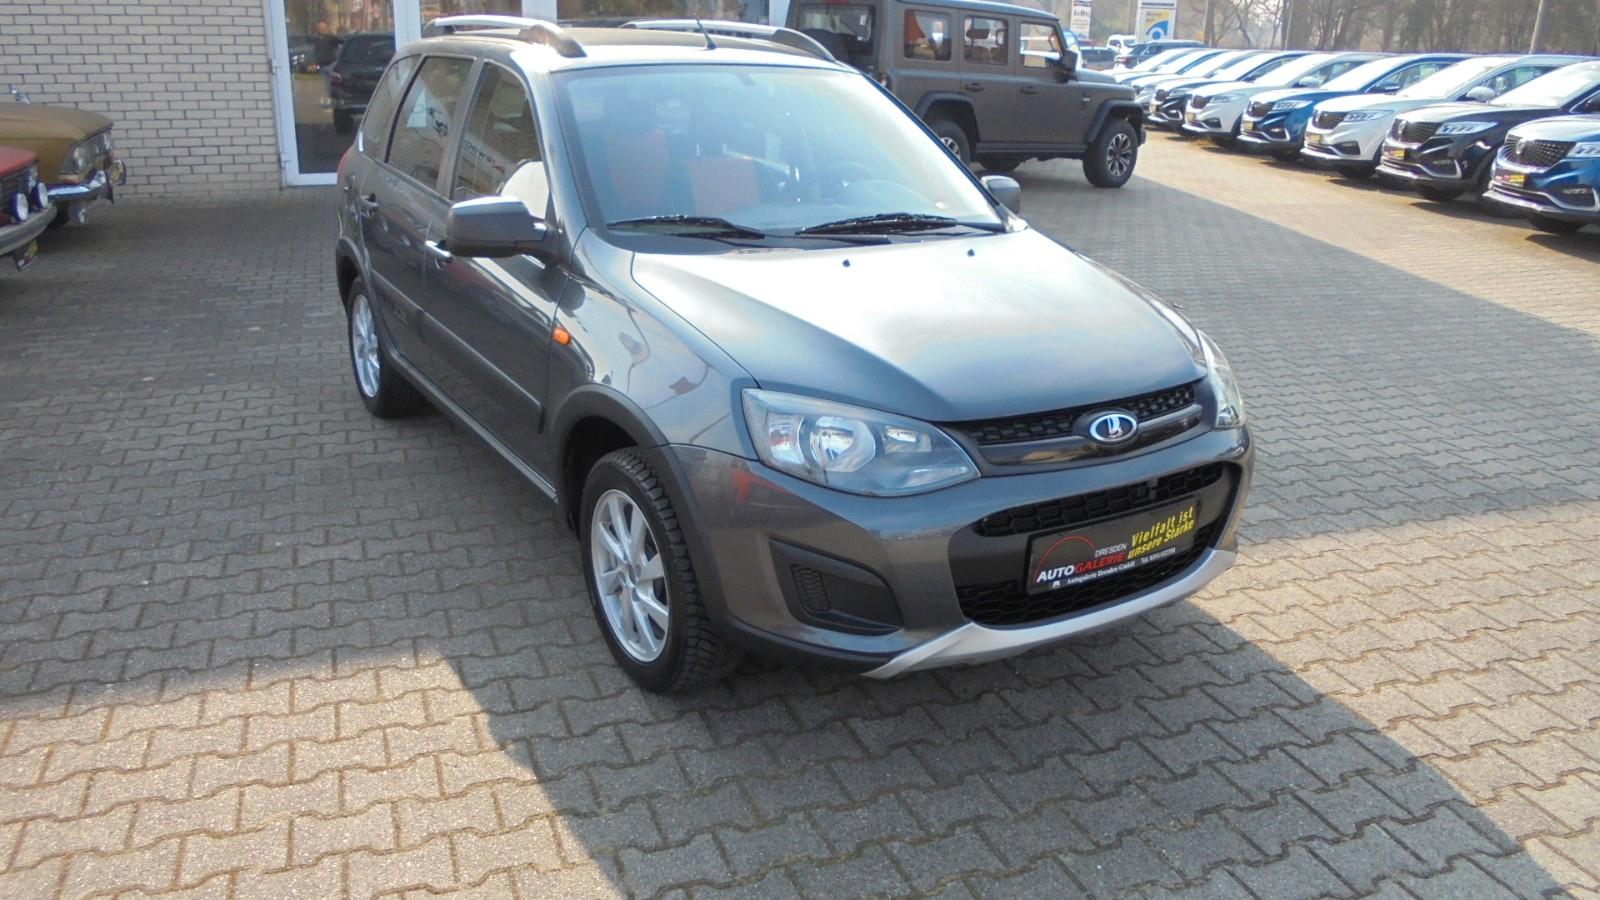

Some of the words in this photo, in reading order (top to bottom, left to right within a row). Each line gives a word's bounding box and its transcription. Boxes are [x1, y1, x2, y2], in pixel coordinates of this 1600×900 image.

[1132, 515, 1175, 547] Vielfalt
[1178, 506, 1193, 525] ist
[1094, 543, 1127, 557] DRESDEN
[1128, 537, 1162, 559] unsere
